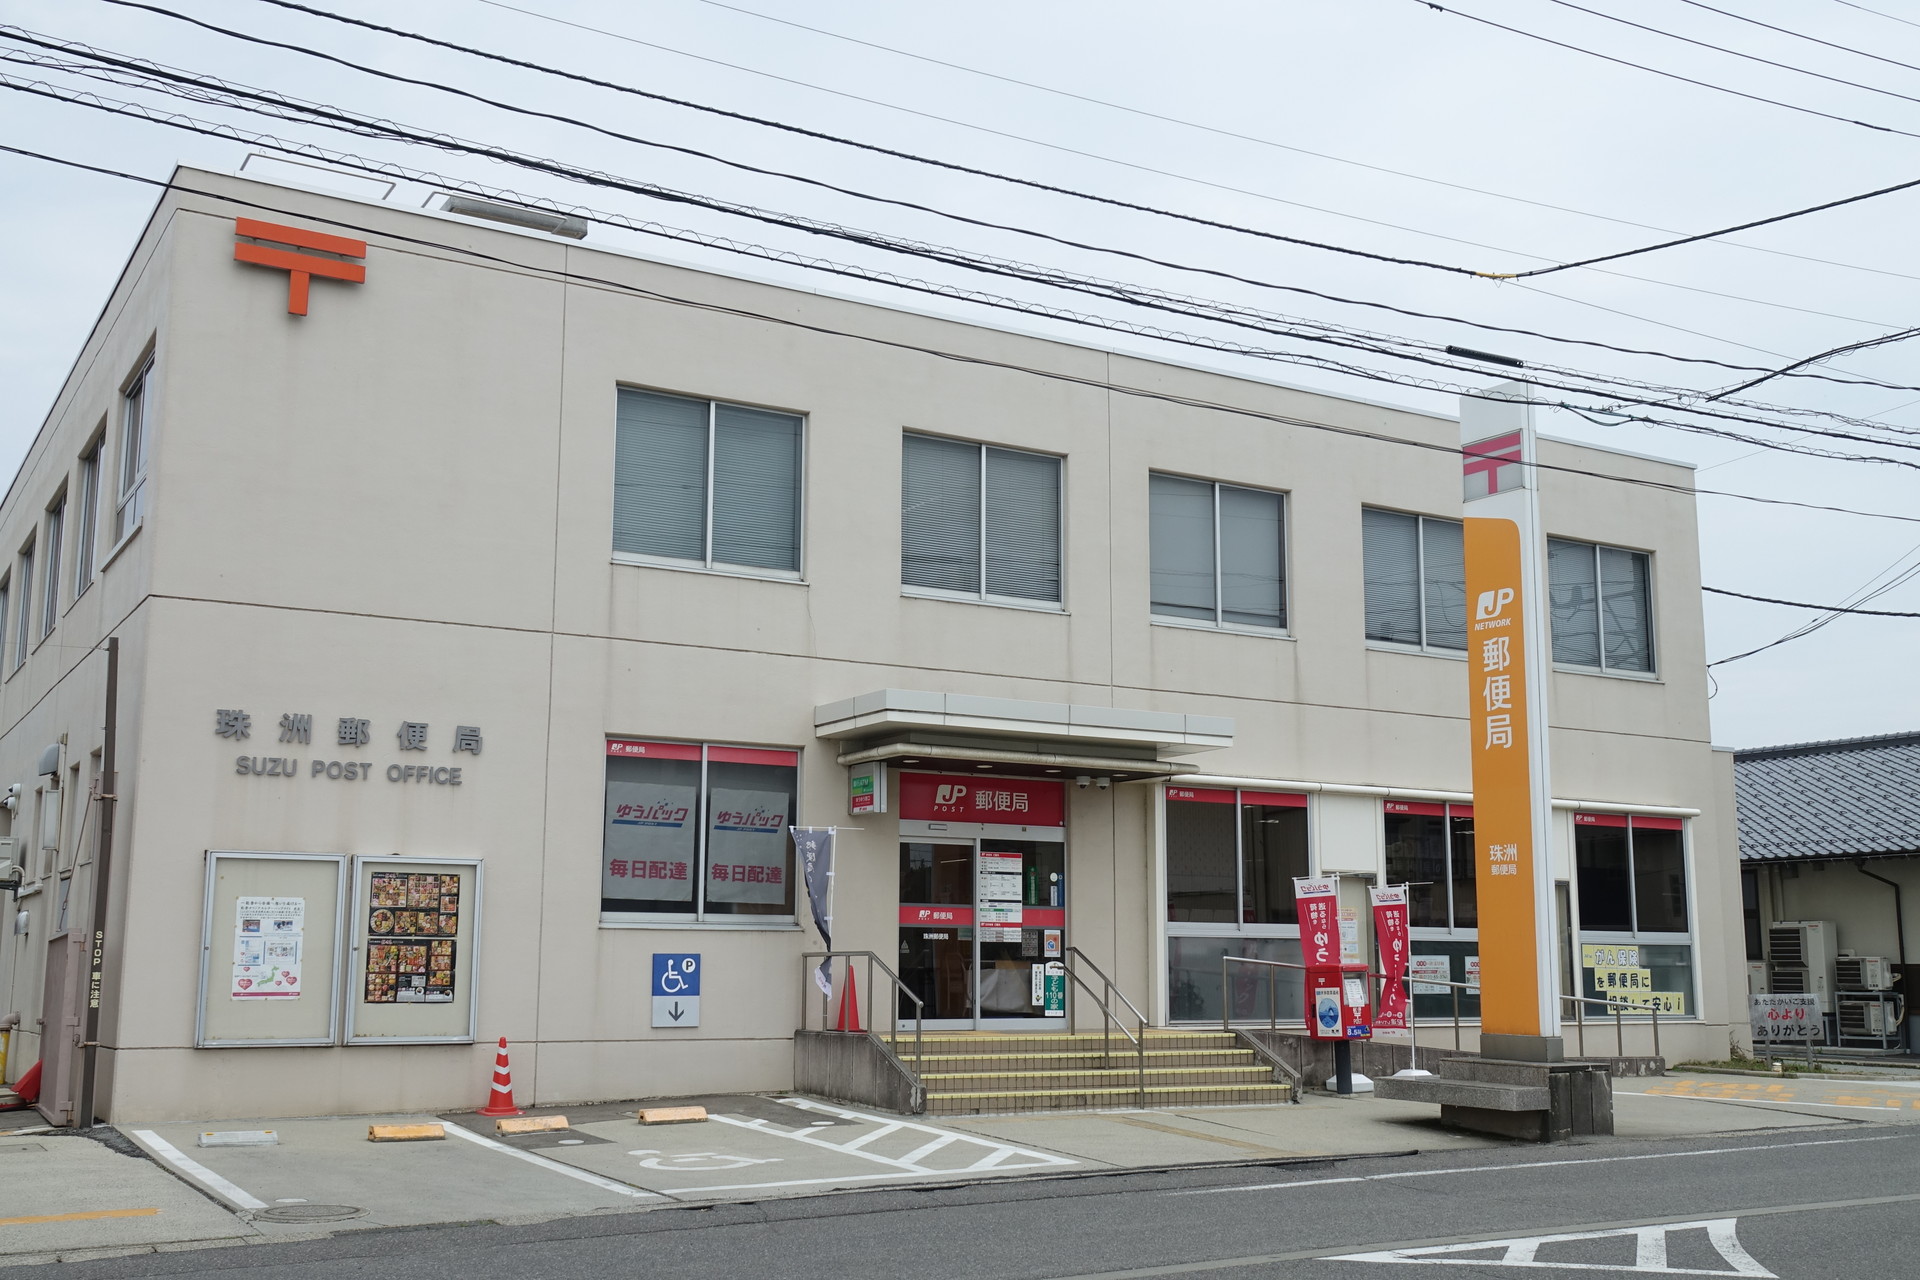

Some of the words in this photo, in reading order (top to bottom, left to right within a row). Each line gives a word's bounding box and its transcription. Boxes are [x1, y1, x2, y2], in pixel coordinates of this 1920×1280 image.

[1474, 618, 1511, 631] NETWORK
[1483, 636, 1512, 750] 郵便局
[215, 709, 483, 755] 珠洲郵便局
[236, 756, 297, 777] SUZU
[311, 760, 372, 780] POST
[386, 764, 462, 785] OFFICE
[975, 790, 1029, 812] 郵便局
[616, 804, 689, 821] ゆうパック
[717, 810, 784, 827] ゆうパック
[1489, 843, 1518, 862] 珠洲
[609, 858, 688, 881] 毎日配達
[711, 863, 782, 884] 毎日配達
[1491, 864, 1517, 875] 郵便局
[933, 912, 953, 920] 郵便局
[93, 930, 103, 966] STOP
[685, 960, 694, 971] P
[1595, 948, 1639, 966] がん保険
[1596, 972, 1650, 988] を郵便局に
[89, 971, 101, 1008] 車に注意
[1754, 998, 1815, 1006] あたたかいご支援
[1767, 1007, 1805, 1020] 心より
[1757, 1024, 1820, 1037] ありがとう
